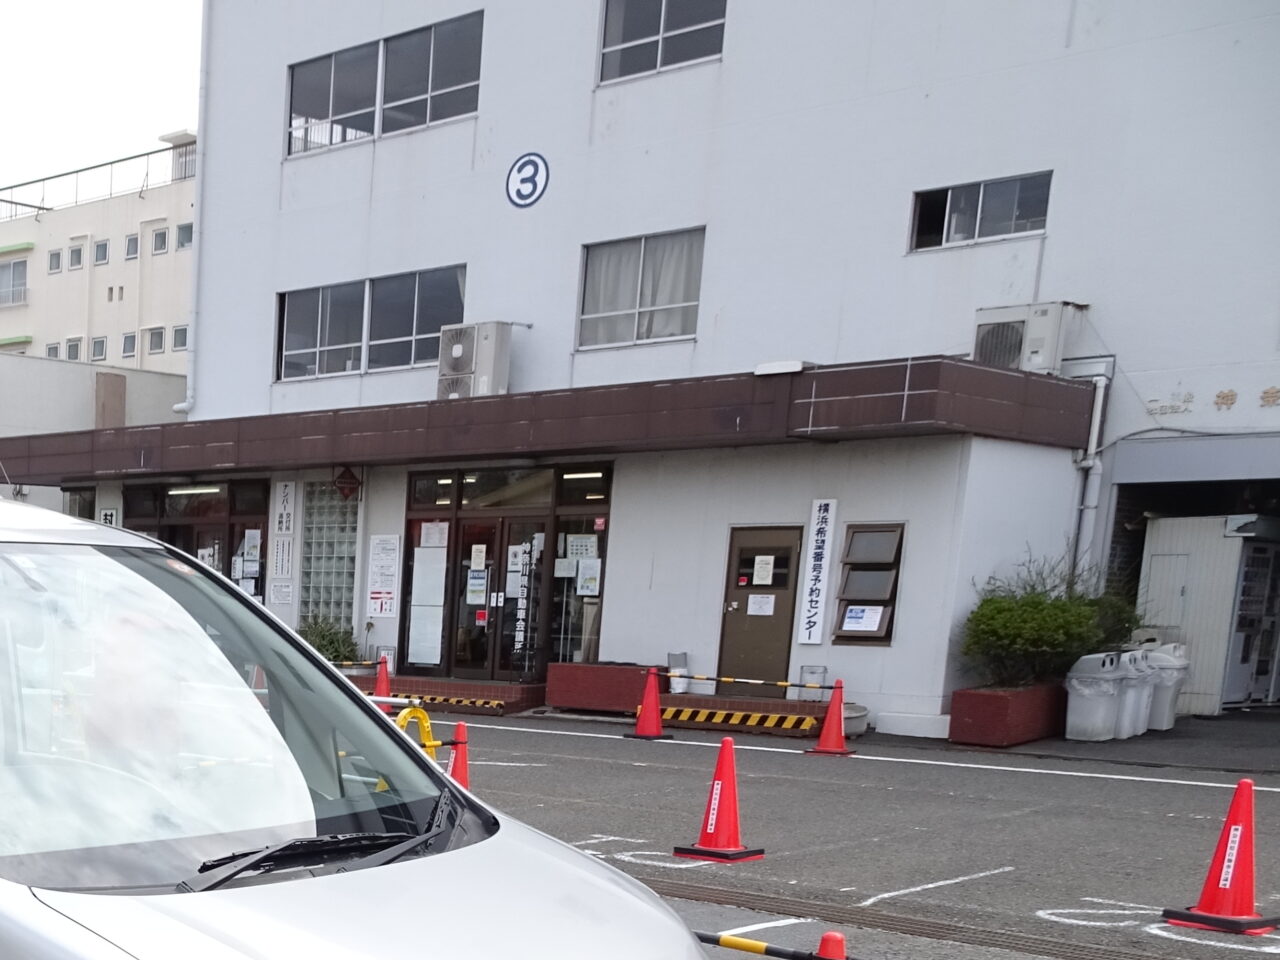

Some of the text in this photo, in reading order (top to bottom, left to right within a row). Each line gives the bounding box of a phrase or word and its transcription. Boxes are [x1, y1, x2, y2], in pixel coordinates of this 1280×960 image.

[281, 483, 290, 512] ナンバー
[805, 502, 831, 641] 横浜希望番号予約センター
